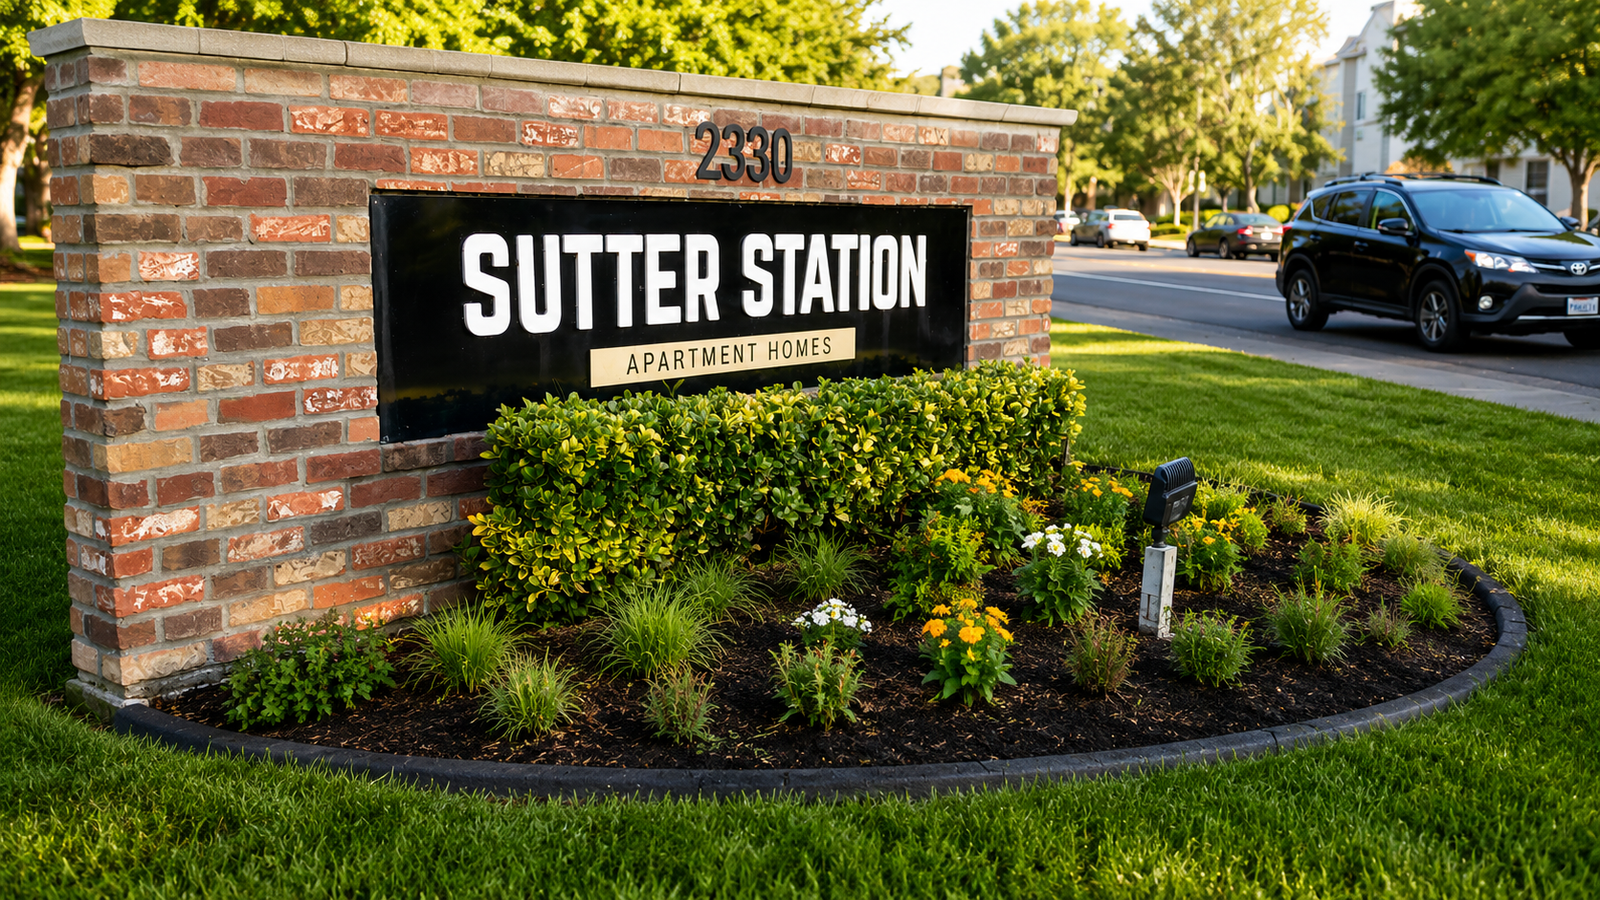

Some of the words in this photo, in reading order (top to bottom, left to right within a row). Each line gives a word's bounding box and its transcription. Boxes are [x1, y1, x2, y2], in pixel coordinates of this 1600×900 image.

[695, 121, 793, 184] 2330
[462, 233, 720, 337] SUTTER
[741, 233, 927, 318] STATION
[626, 343, 757, 375] APARTMENT
[768, 336, 832, 360] HOMES
